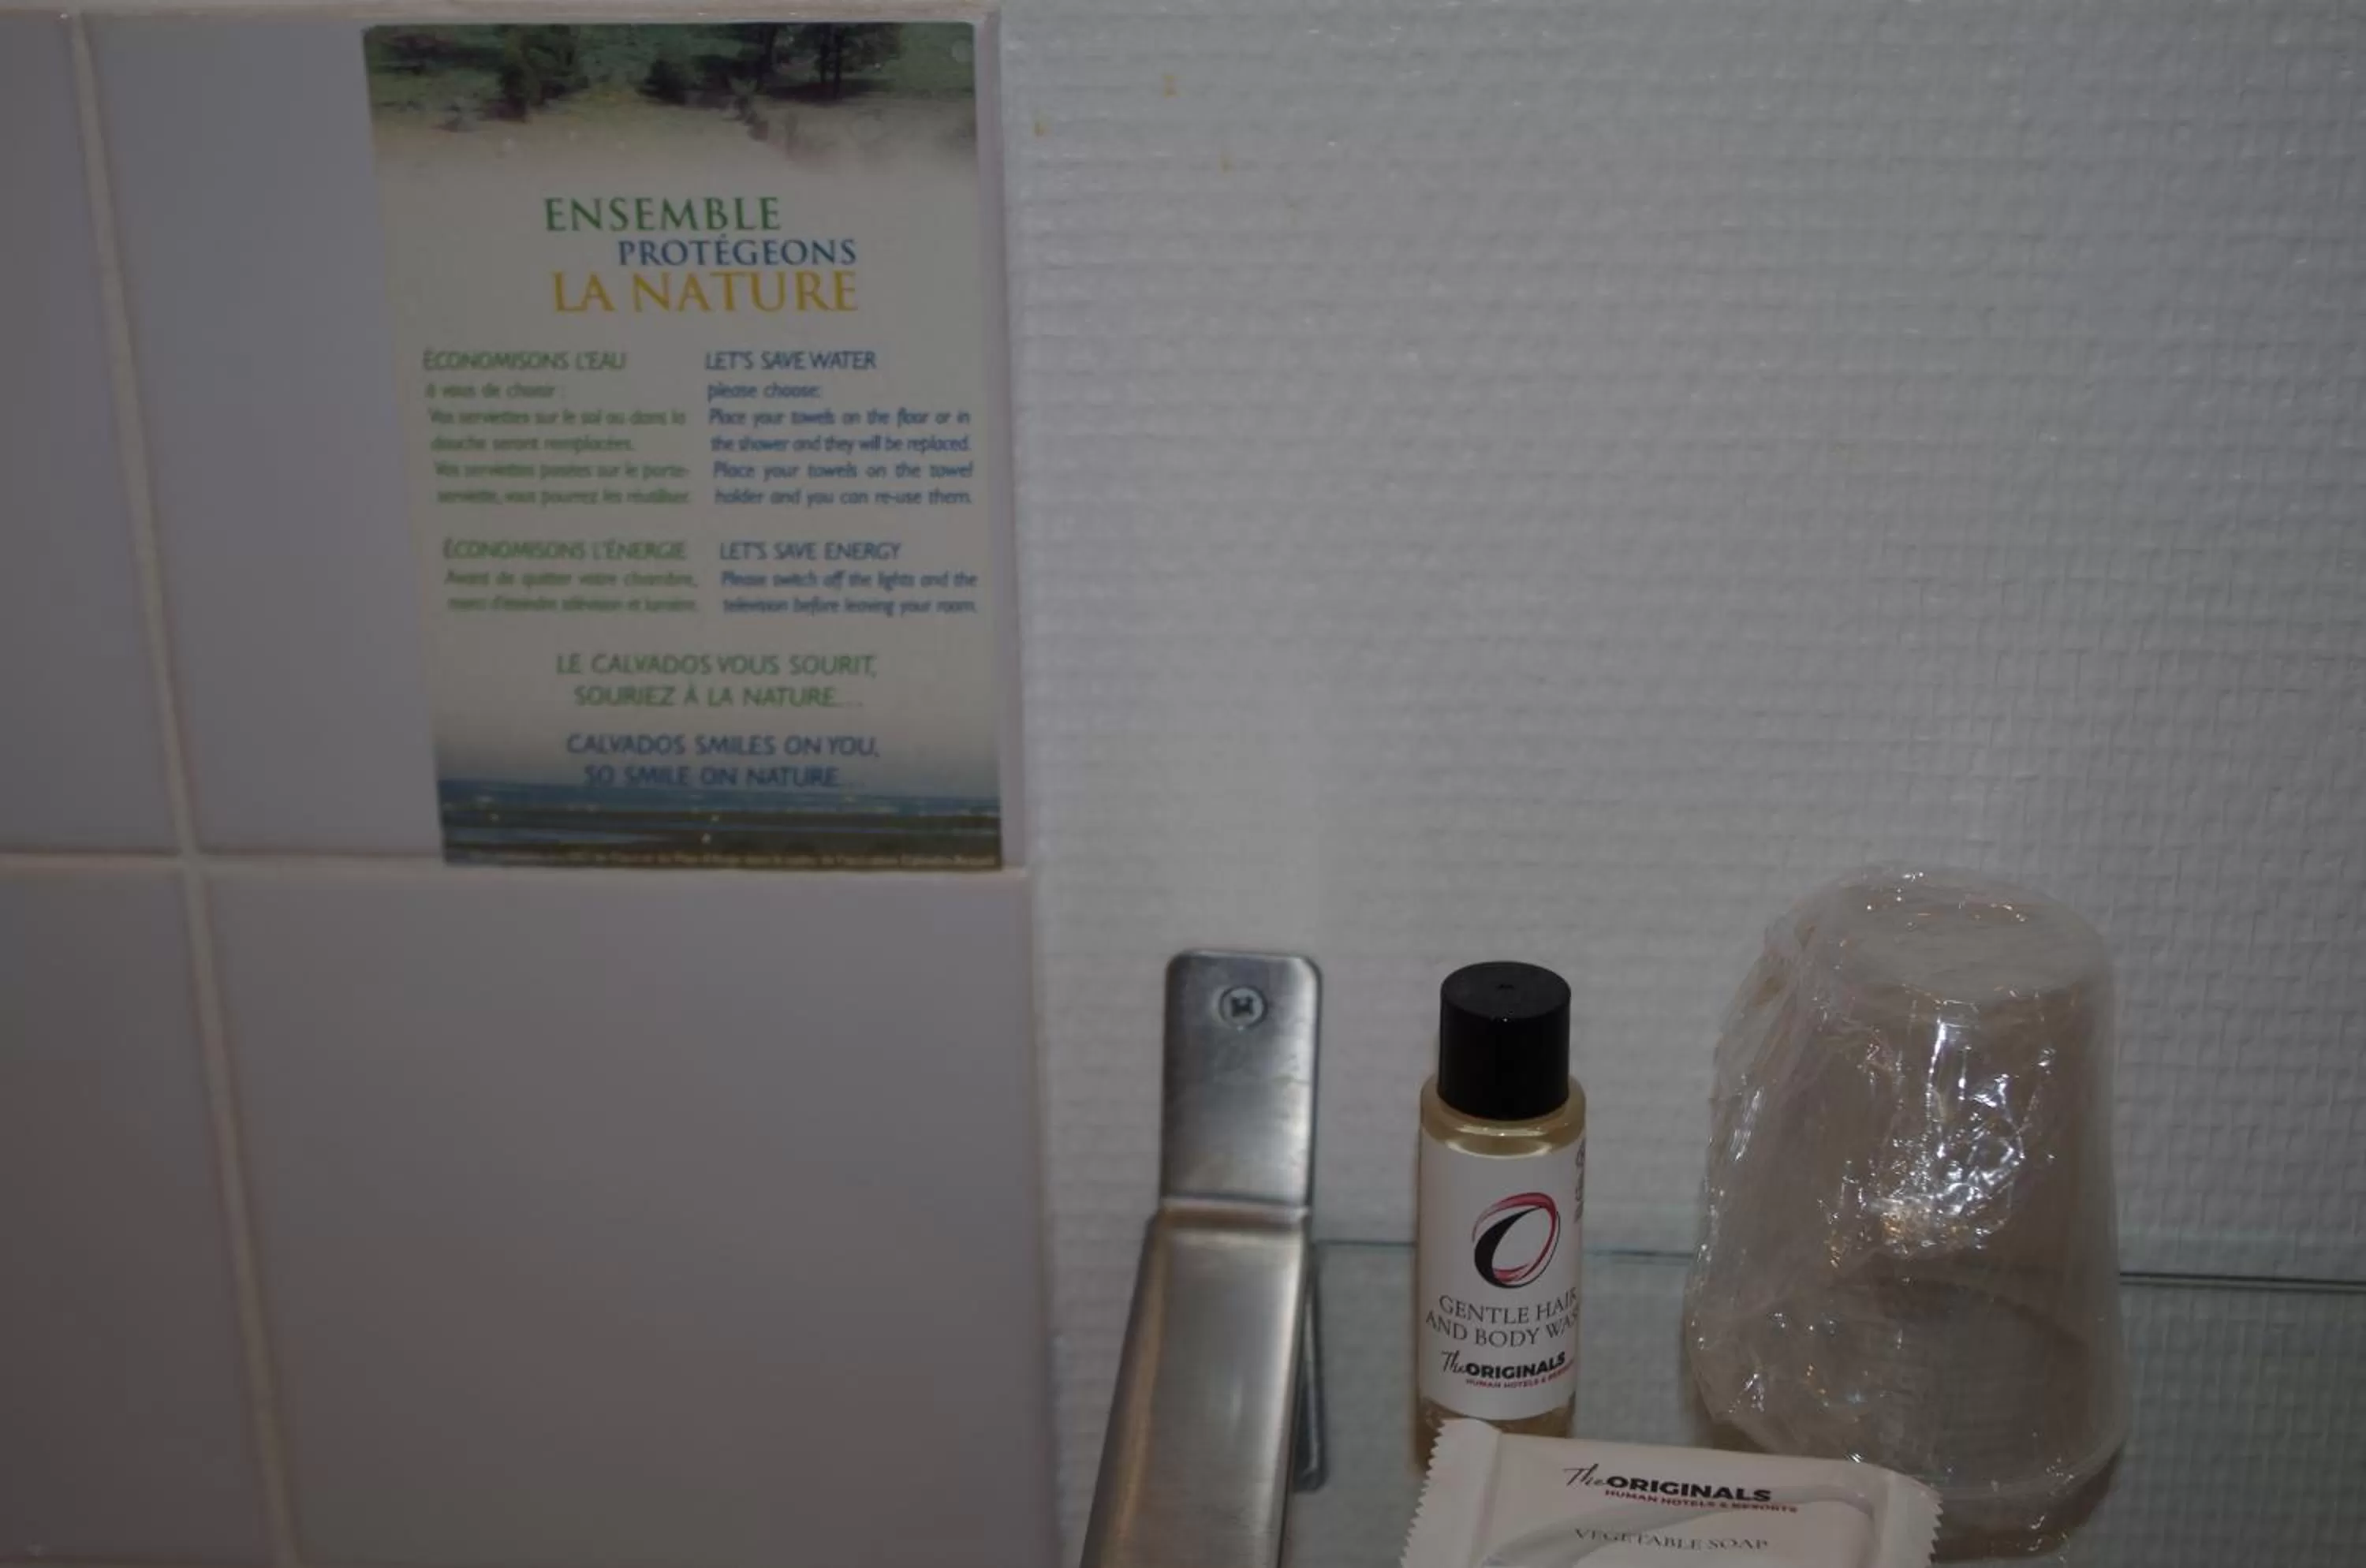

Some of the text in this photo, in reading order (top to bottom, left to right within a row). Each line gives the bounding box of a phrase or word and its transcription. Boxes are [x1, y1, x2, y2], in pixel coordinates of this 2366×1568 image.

[545, 196, 781, 231] ENSEMBLE
[619, 234, 857, 266] PROTÉGEONS
[553, 271, 859, 312] LA NATURE
[423, 348, 626, 370] ÉCONOMISONS L'EAU
[704, 350, 877, 370] LET'S SAVE WATER
[707, 381, 757, 403] please
[708, 406, 970, 429] Place your towels on the floor or in
[710, 435, 733, 452] the
[738, 435, 789, 452] shower
[792, 435, 821, 452] and
[824, 435, 854, 455] they
[859, 434, 881, 452] will
[885, 435, 903, 452] be
[713, 460, 974, 483] Place your towels on the towel
[715, 487, 764, 505] holder
[770, 487, 801, 505] and
[807, 491, 834, 507] you
[839, 491, 868, 505] can
[875, 491, 922, 505] re-use
[719, 541, 901, 560] LET'S SAVE ENERGY
[721, 569, 978, 592] Please switch off the lights and the
[722, 596, 789, 613] television
[793, 595, 841, 617] before
[845, 597, 895, 617] leaving
[899, 600, 931, 617] your
[557, 653, 877, 678] LE CALVADOS VOUS SOURIT,
[573, 685, 676, 707] SOURIEZ
[683, 682, 700, 707] À
[708, 686, 734, 707] LA
[566, 732, 685, 756] CALVADOS
[694, 734, 776, 756] SMILES
[784, 734, 821, 756] ON
[584, 764, 615, 786] SO
[623, 765, 689, 786] SMILE
[700, 766, 738, 787] ON
[1439, 1294, 1530, 1325] GENTLE
[1425, 1309, 1468, 1341] AND
[1475, 1327, 1540, 1348] BODY
[1465, 1378, 1501, 1388] HUMAN
[1503, 1378, 1539, 1388] HOTELS
[1605, 1489, 1657, 1503] HUMAN
[1661, 1497, 1715, 1509] HOTELS
[1731, 1502, 1798, 1514] RESORTS
[1574, 1527, 1768, 1551] VEGETABLE SOAP
